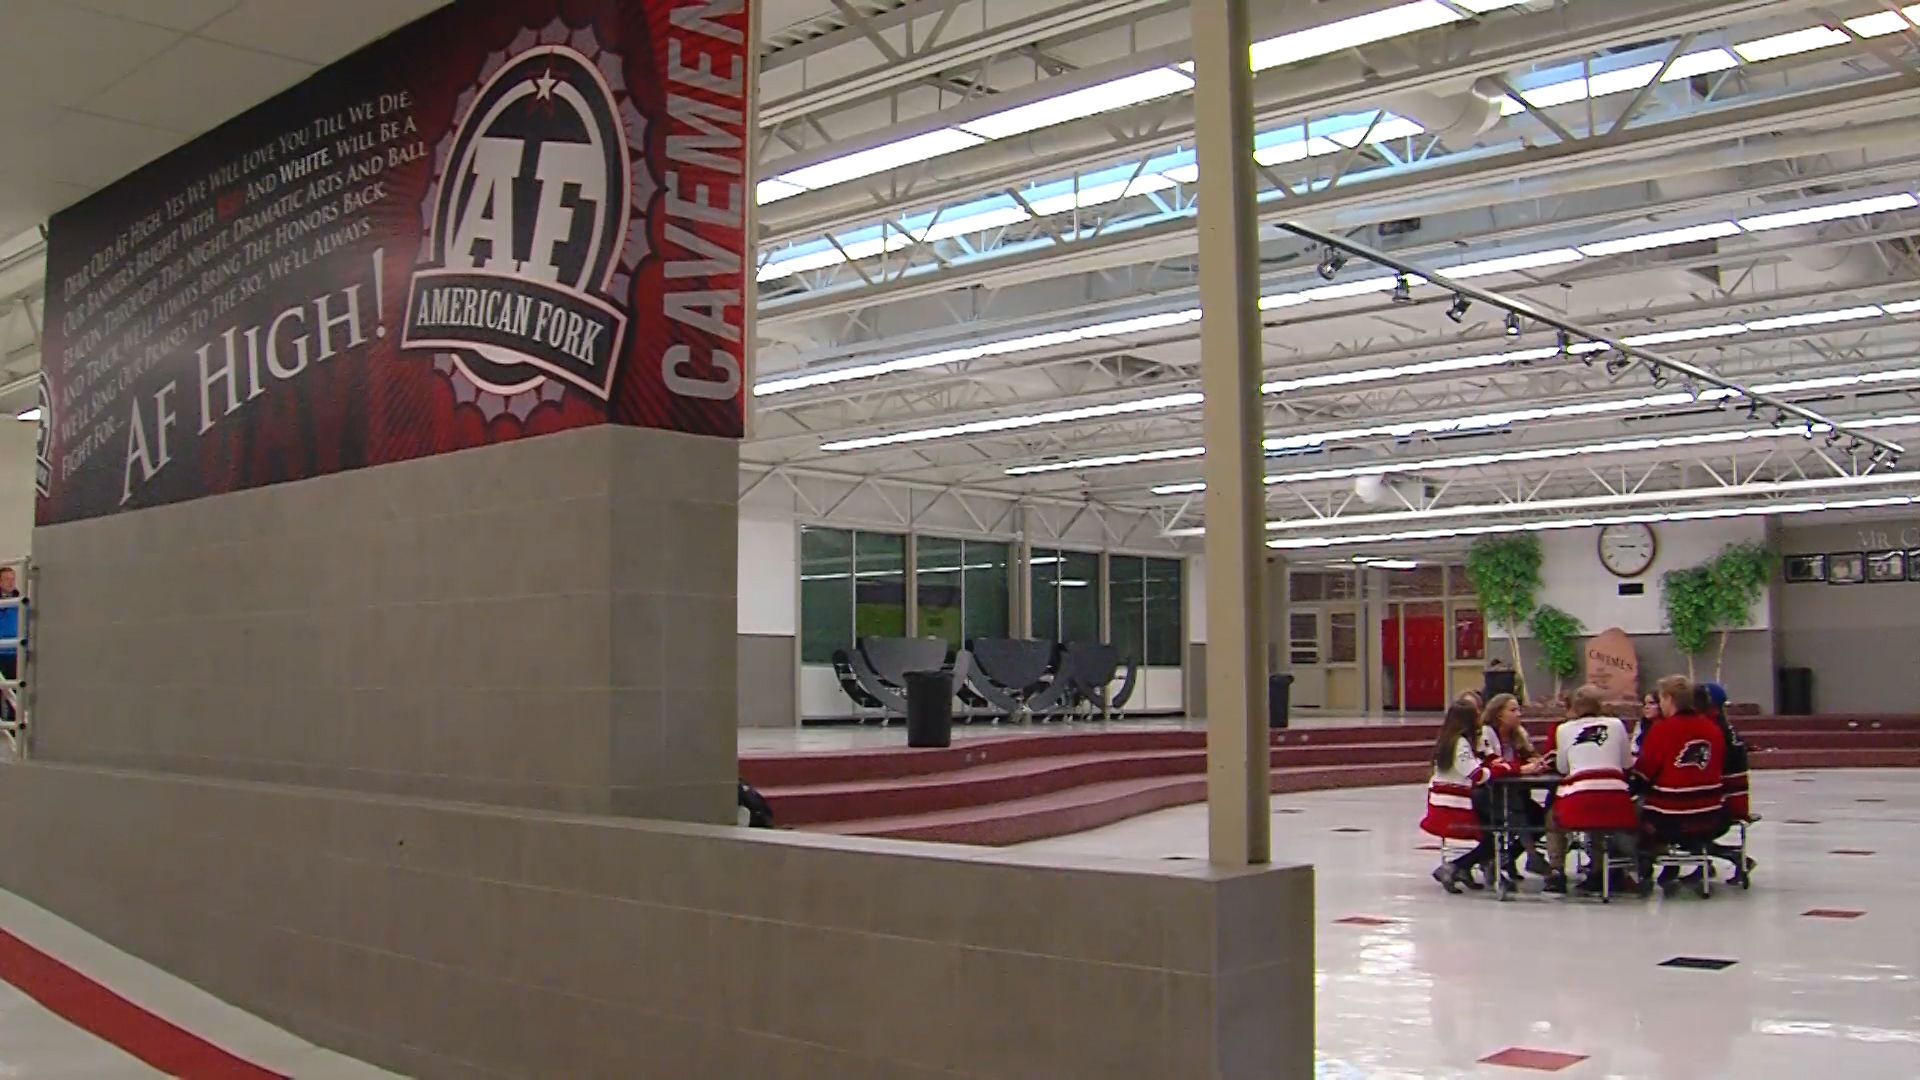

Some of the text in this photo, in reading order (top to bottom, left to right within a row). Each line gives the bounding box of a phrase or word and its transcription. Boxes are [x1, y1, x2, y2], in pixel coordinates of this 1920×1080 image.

[136, 229, 179, 276] BRIGHT
[181, 207, 214, 242] WITH
[245, 173, 277, 204] AND
[336, 131, 376, 158] WILL
[380, 121, 400, 142] BE
[403, 114, 417, 134] A
[165, 193, 185, 220] YES
[187, 179, 207, 204] WE
[208, 161, 240, 192] WILL
[243, 143, 276, 174] LOVE
[279, 127, 310, 154] YOU
[313, 113, 346, 138] TILL
[348, 102, 375, 123] WE
[449, 136, 599, 284] AF
[104, 278, 160, 336] THROUGH
[160, 258, 184, 290] THE
[233, 189, 303, 242] DRAMATIC
[305, 171, 343, 203] ARTS
[346, 155, 383, 184] AND
[388, 141, 428, 168] BALL
[155, 281, 199, 326] ALWAYS
[201, 253, 241, 294] BRING
[243, 235, 271, 266] THE
[275, 201, 339, 248] HONORS
[190, 309, 209, 334] TO
[211, 287, 237, 318] THE
[312, 216, 370, 260] ALWAYS
[120, 246, 386, 505] AF HIGH!
[416, 287, 604, 366] AMERICAN FORK
